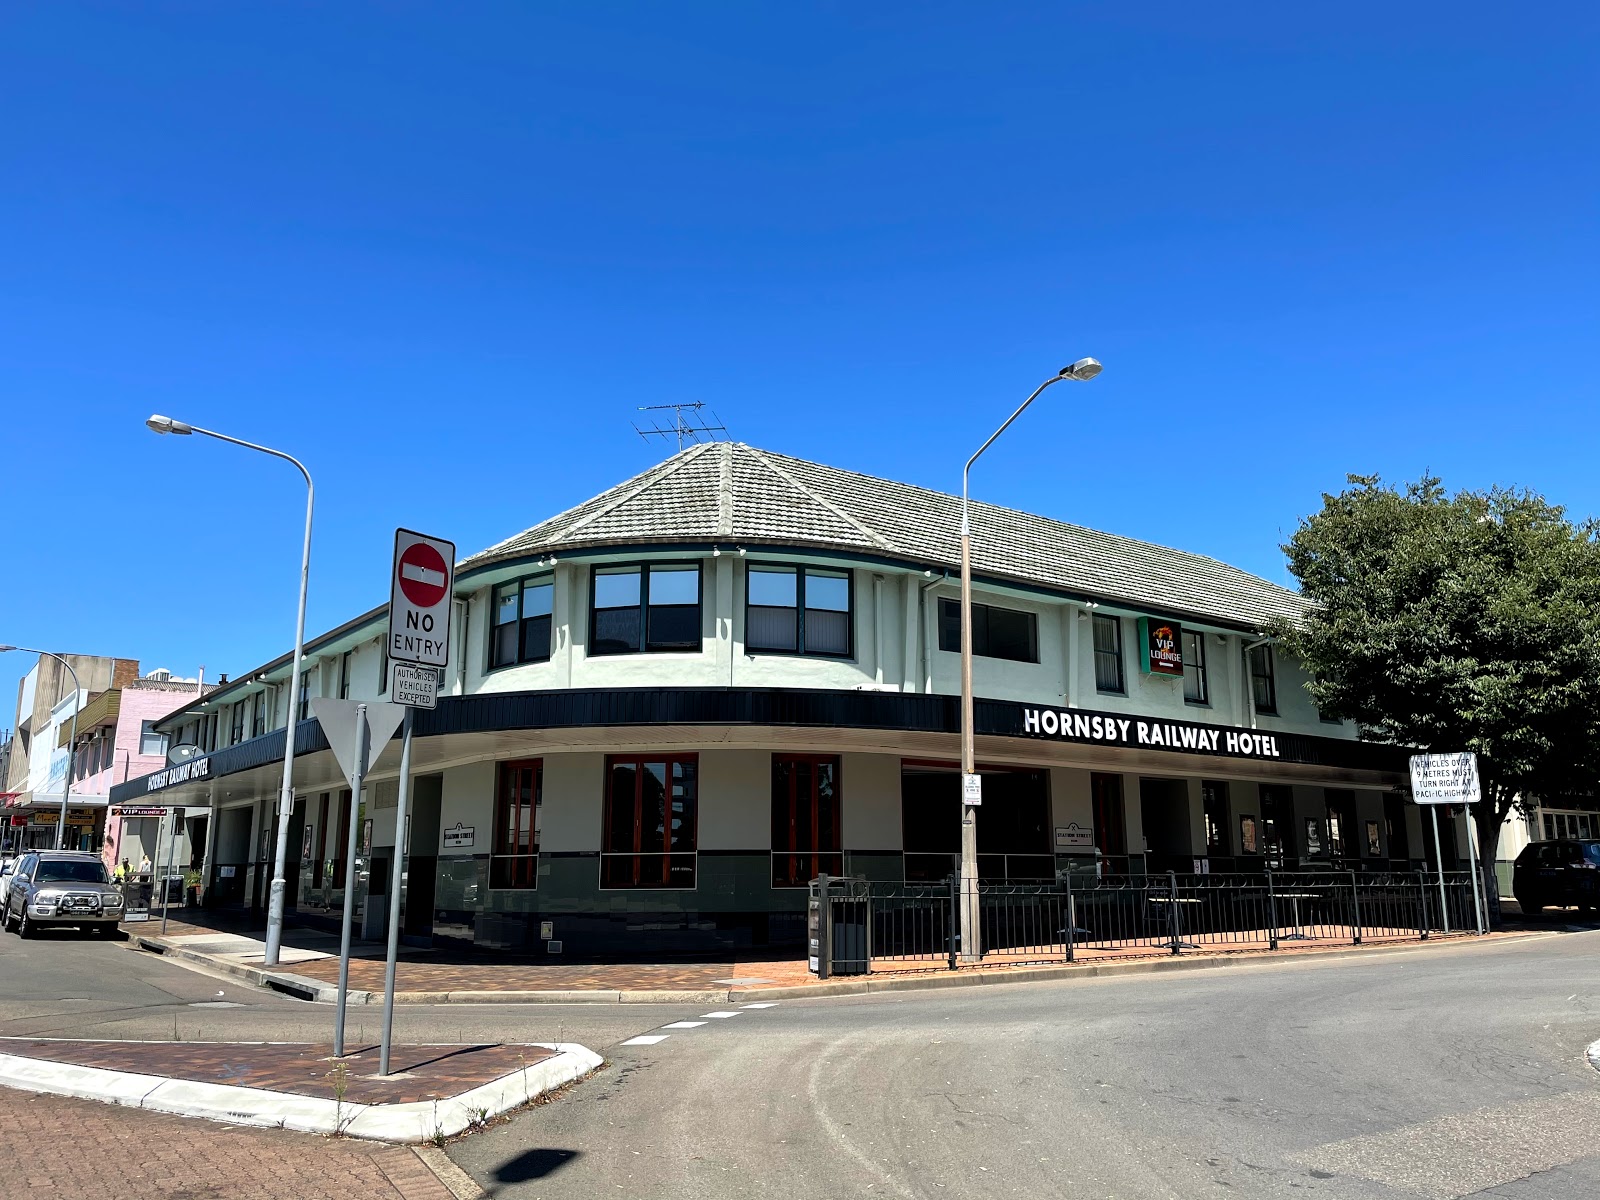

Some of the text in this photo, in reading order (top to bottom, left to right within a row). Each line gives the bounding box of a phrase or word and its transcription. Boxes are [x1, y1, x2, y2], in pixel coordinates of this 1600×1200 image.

[406, 610, 434, 633] NO
[394, 634, 444, 657] ENTRY
[1156, 638, 1174, 650] VIP
[1150, 649, 1182, 663] LOUNGE
[397, 668, 436, 682] AUTHORISED
[399, 680, 433, 693] VEHICLES
[398, 691, 431, 704] EXCEPTED
[1024, 708, 1280, 757] HORNSBY RAILWAY HOTEL
[190, 757, 209, 779] HOTEL
[1415, 758, 1471, 769] VEHICLES OVER
[1423, 769, 1451, 778] METRES
[1452, 768, 1472, 777] MUST
[1419, 778, 1471, 788] TURN RIGHT AT
